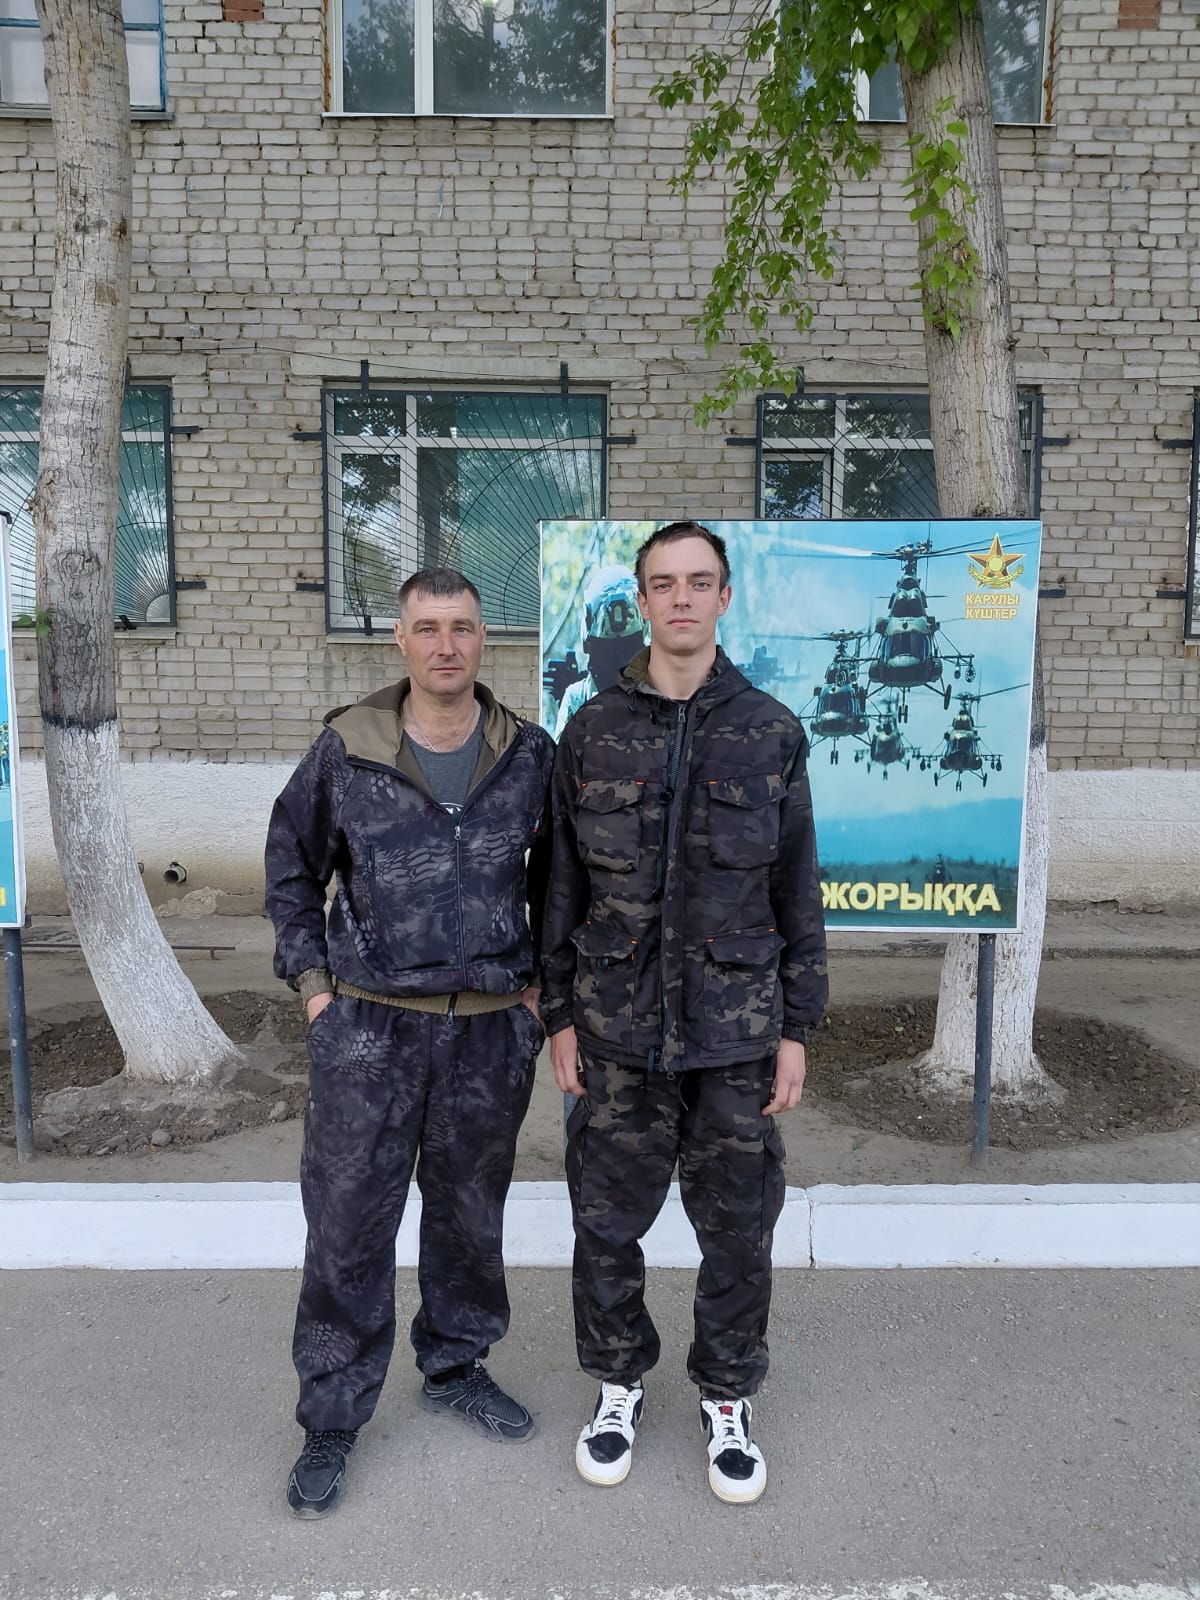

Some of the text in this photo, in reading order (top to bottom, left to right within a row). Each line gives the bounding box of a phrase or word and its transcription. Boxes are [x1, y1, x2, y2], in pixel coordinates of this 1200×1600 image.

[966, 593, 1020, 608] ҚАРУЛЫ
[966, 608, 1018, 620] КҮШТЕР
[820, 881, 1002, 917] ЖОРЫҚҚА
